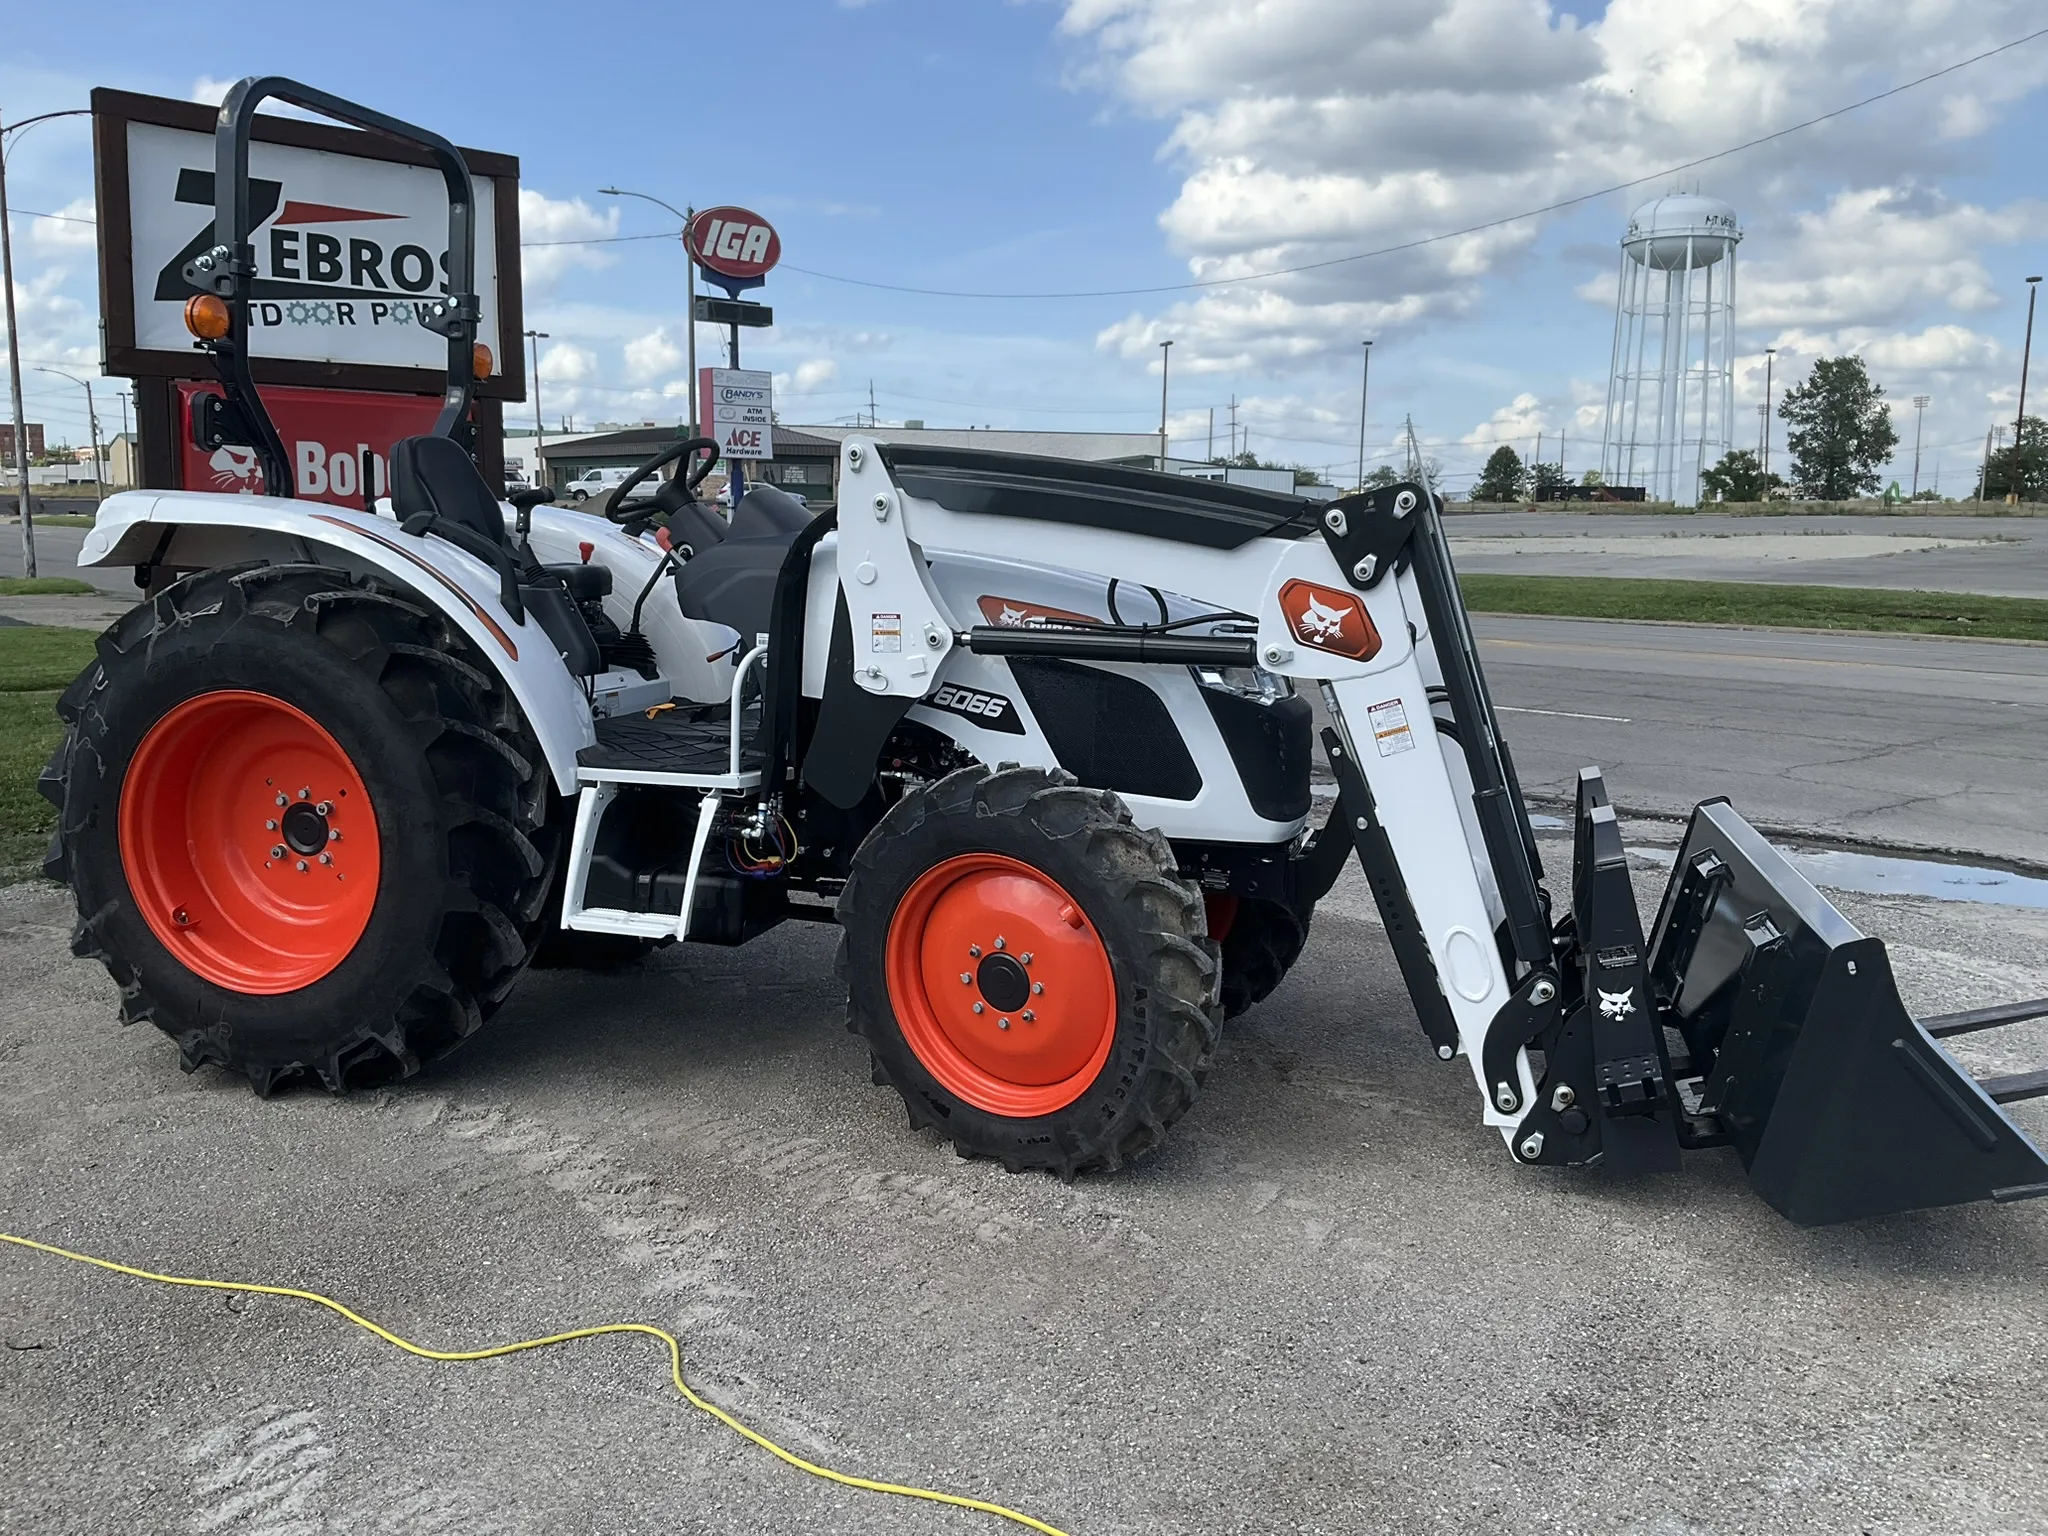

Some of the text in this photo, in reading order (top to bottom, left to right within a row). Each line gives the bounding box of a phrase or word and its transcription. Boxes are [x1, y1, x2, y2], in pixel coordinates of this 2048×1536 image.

[702, 219, 771, 264] IGA
[248, 301, 438, 326] TDOOR POW
[726, 389, 763, 399] BANDY'S
[742, 415, 767, 423] INSIDE
[747, 407, 763, 415] ATM
[726, 427, 762, 447] ACE
[726, 447, 763, 456] Hardware
[296, 440, 391, 497] Bob
[933, 686, 1008, 718] 6066
